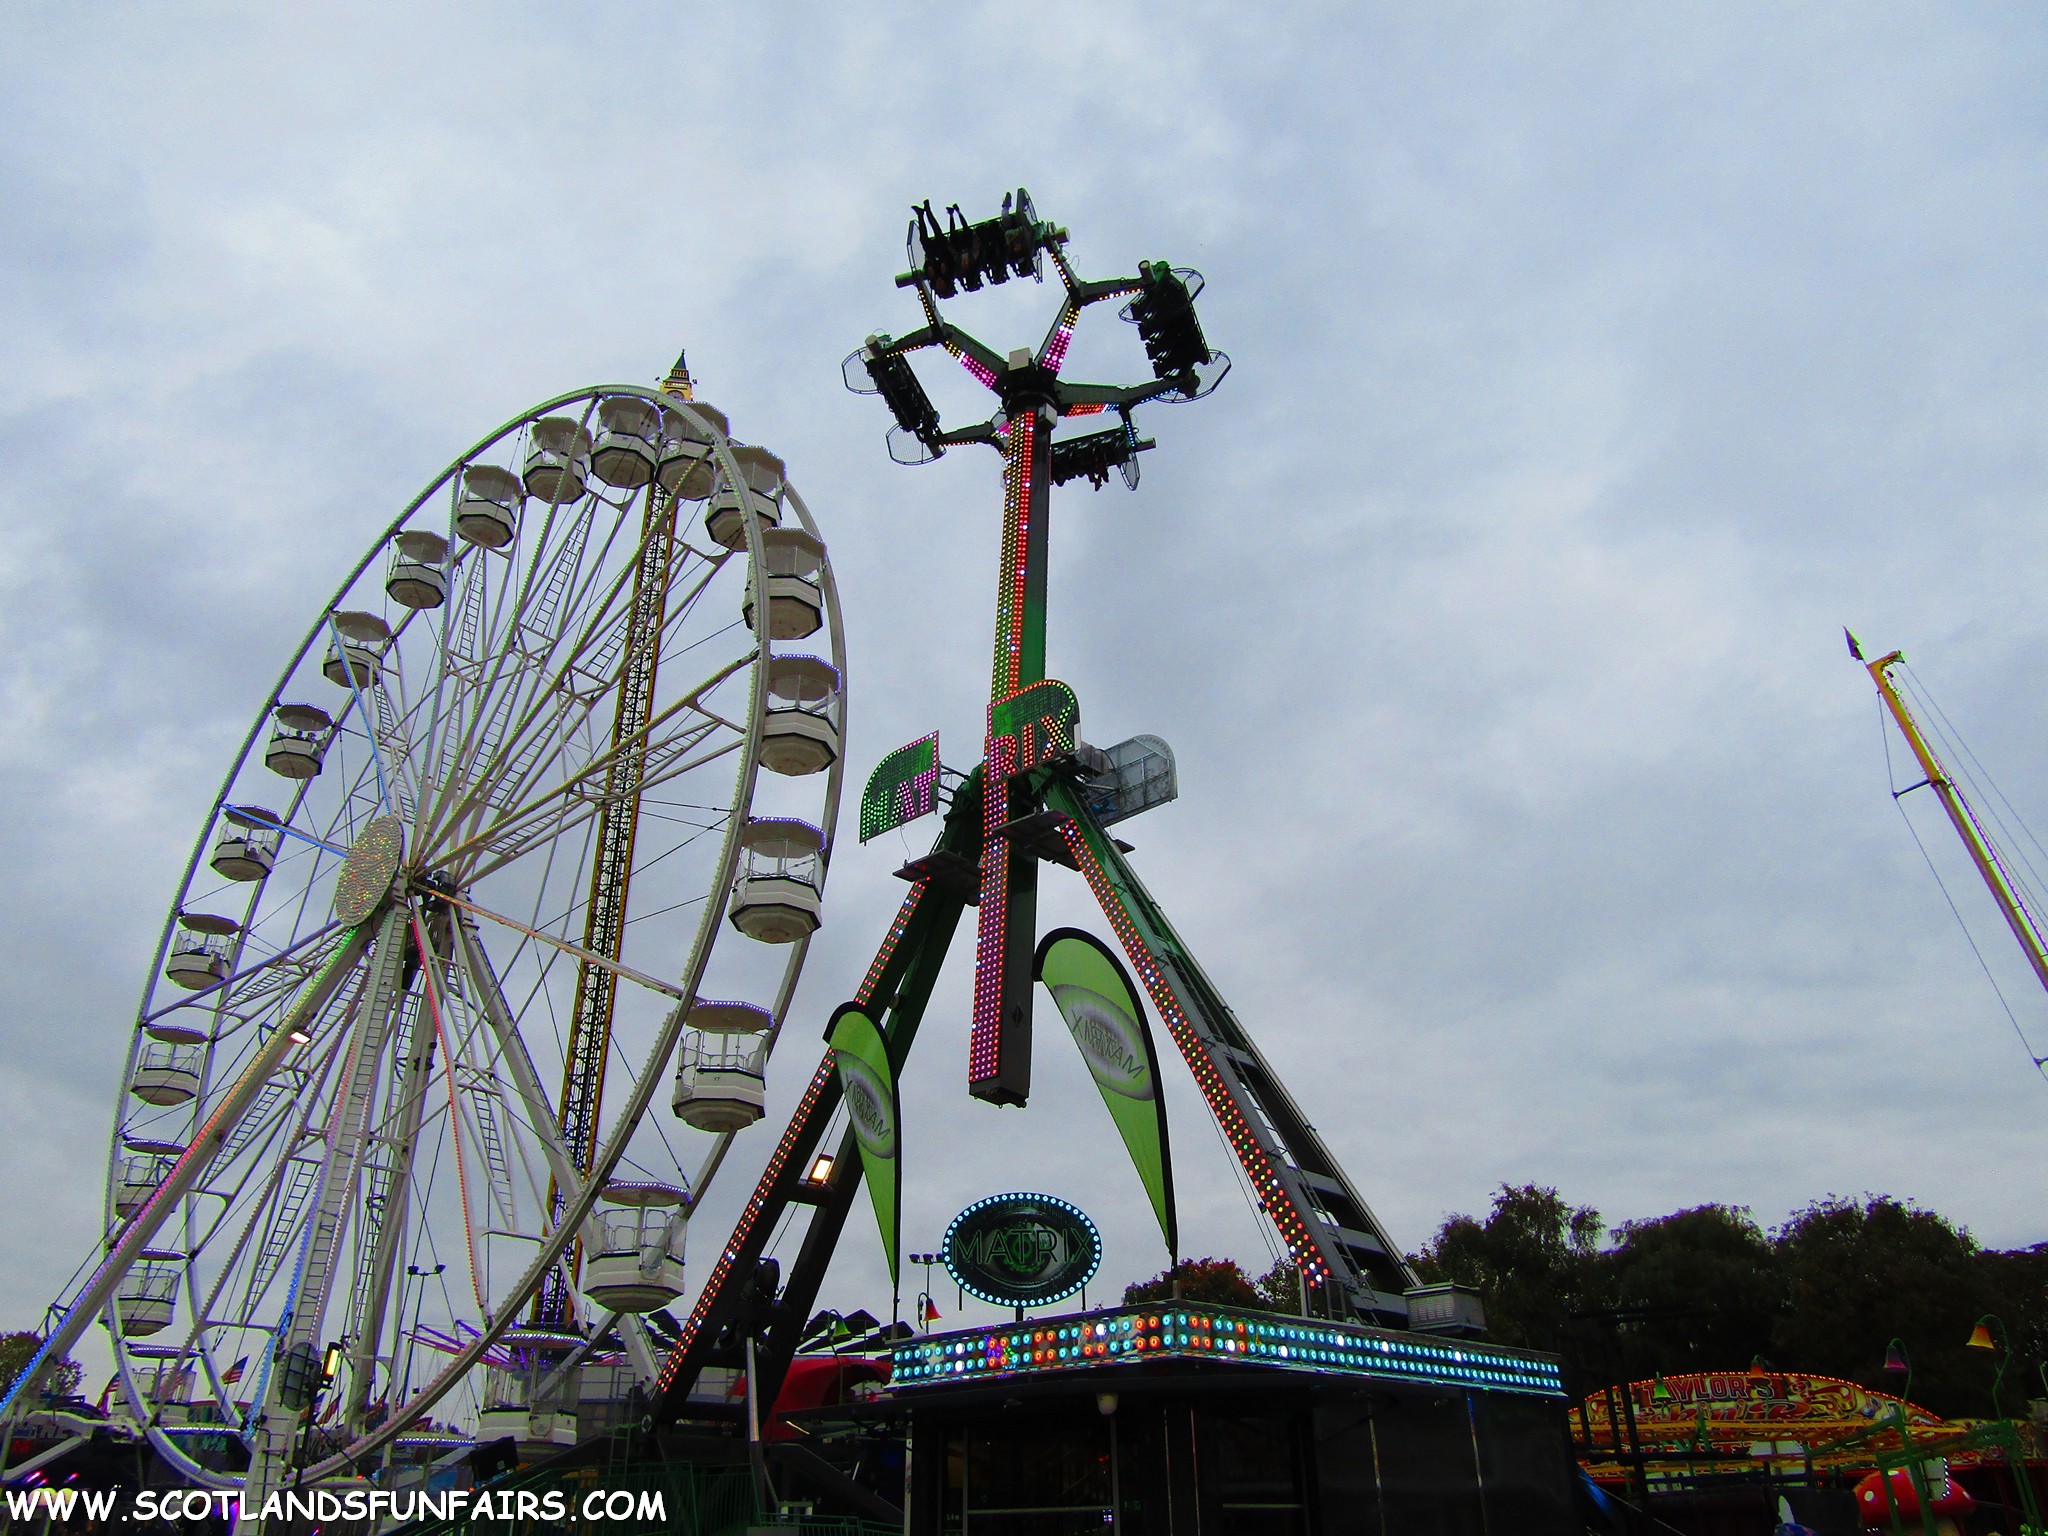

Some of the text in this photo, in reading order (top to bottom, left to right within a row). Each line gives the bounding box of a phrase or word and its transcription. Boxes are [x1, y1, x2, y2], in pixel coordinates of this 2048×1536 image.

[861, 706, 1075, 839] MAT RIX
[951, 1228, 1095, 1265] MATRIX
